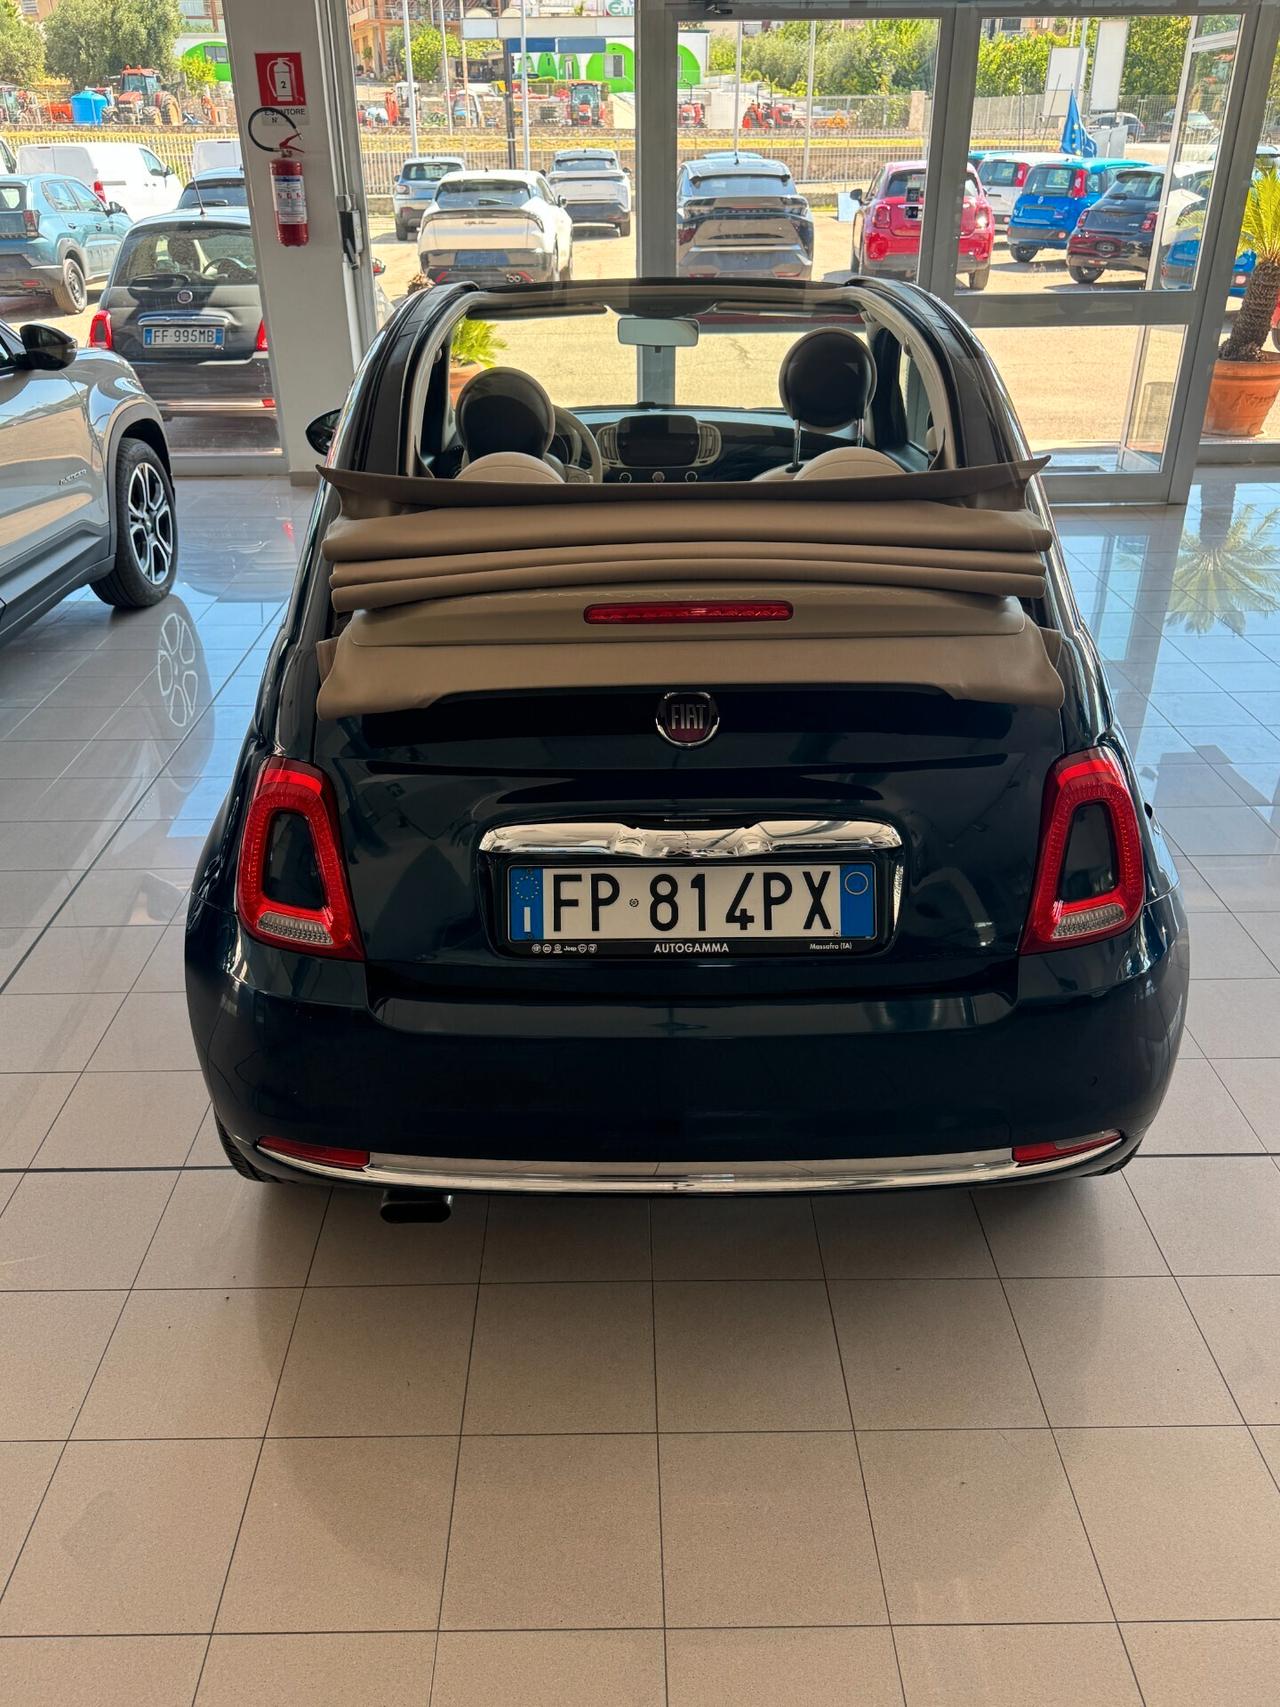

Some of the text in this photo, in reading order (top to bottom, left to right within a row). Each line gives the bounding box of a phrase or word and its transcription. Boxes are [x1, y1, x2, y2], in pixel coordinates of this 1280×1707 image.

[281, 80, 287, 89] 2
[153, 329, 215, 343] FF 995MB
[671, 703, 708, 730] FIAT
[552, 871, 832, 932] FP 814PX
[523, 906, 531, 933] I
[653, 943, 730, 953] AUTOGAMMA
